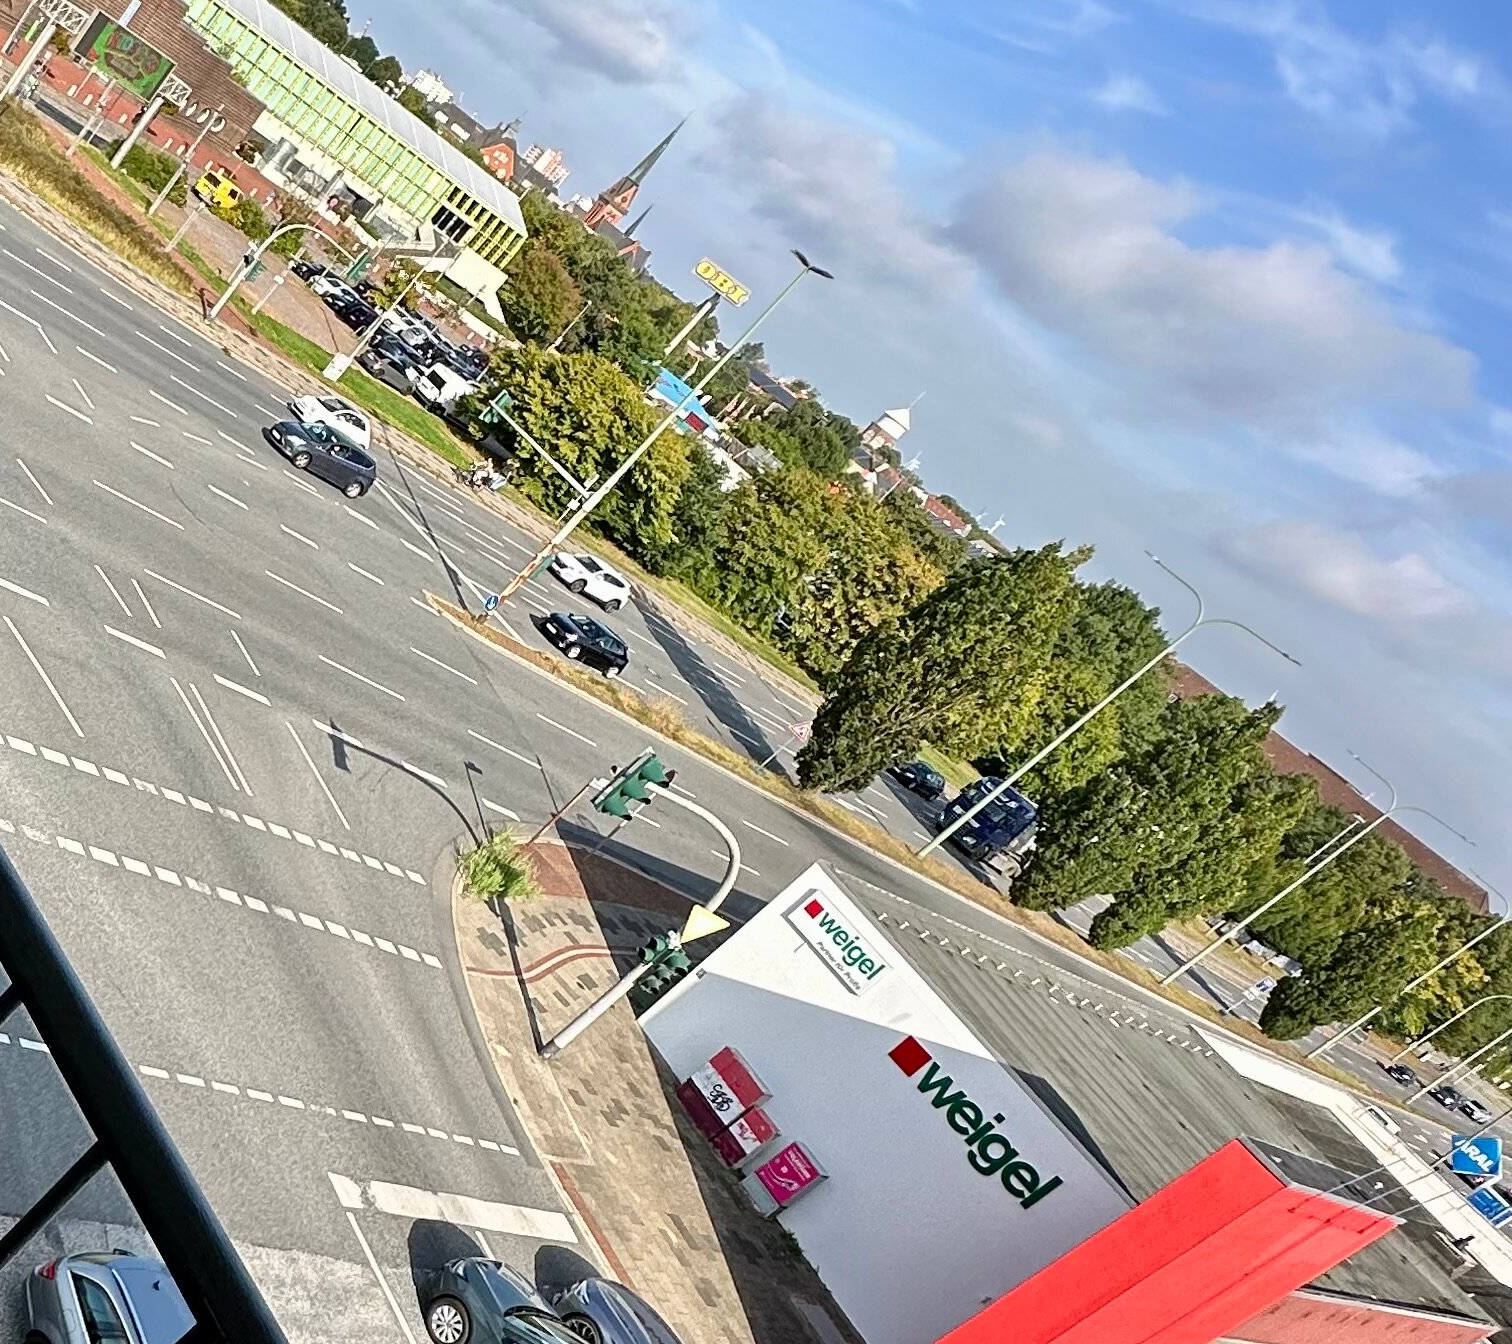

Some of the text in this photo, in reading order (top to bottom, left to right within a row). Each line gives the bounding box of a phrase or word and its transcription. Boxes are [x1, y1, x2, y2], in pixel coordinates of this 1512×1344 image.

[695, 261, 748, 304] OBI
[815, 940, 836, 963] Partner
[818, 912, 885, 980] weigel
[916, 1062, 1063, 1209] weigel
[1455, 1139, 1493, 1172] ARAL
